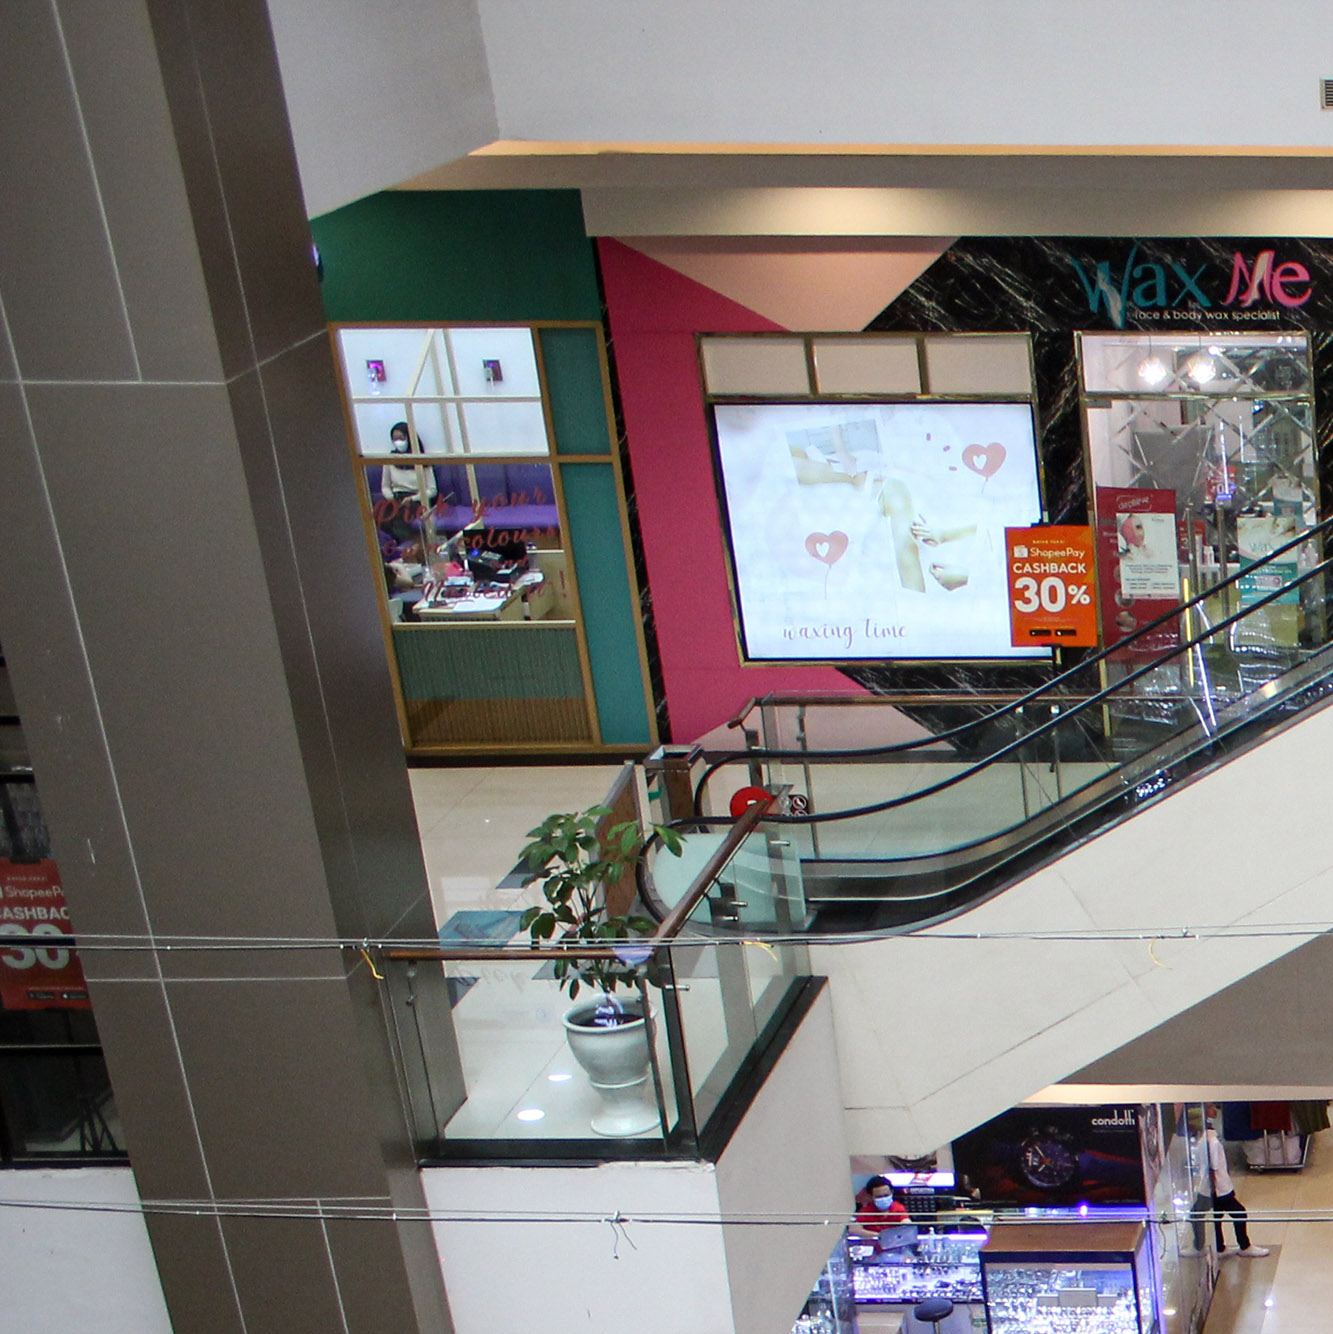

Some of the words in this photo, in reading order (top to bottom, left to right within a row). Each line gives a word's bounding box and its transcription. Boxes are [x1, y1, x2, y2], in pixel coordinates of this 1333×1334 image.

[1070, 240, 1212, 329] Wax
[1223, 250, 1312, 307] Me
[1134, 310, 1160, 320] face
[1163, 311, 1171, 320] &
[1173, 310, 1202, 321] body
[1205, 311, 1229, 320] wax
[1231, 310, 1281, 321] specialist
[472, 487, 546, 518] your
[1029, 546, 1086, 559] ShopeePay
[1013, 562, 1087, 575] CASHBACK
[1014, 577, 1090, 613] 30%
[782, 625, 853, 648] waxing
[864, 618, 907, 639] time
[5, 885, 64, 899] ShopeeP
[0, 906, 69, 920] ASHBAC
[0, 923, 70, 970] 30
